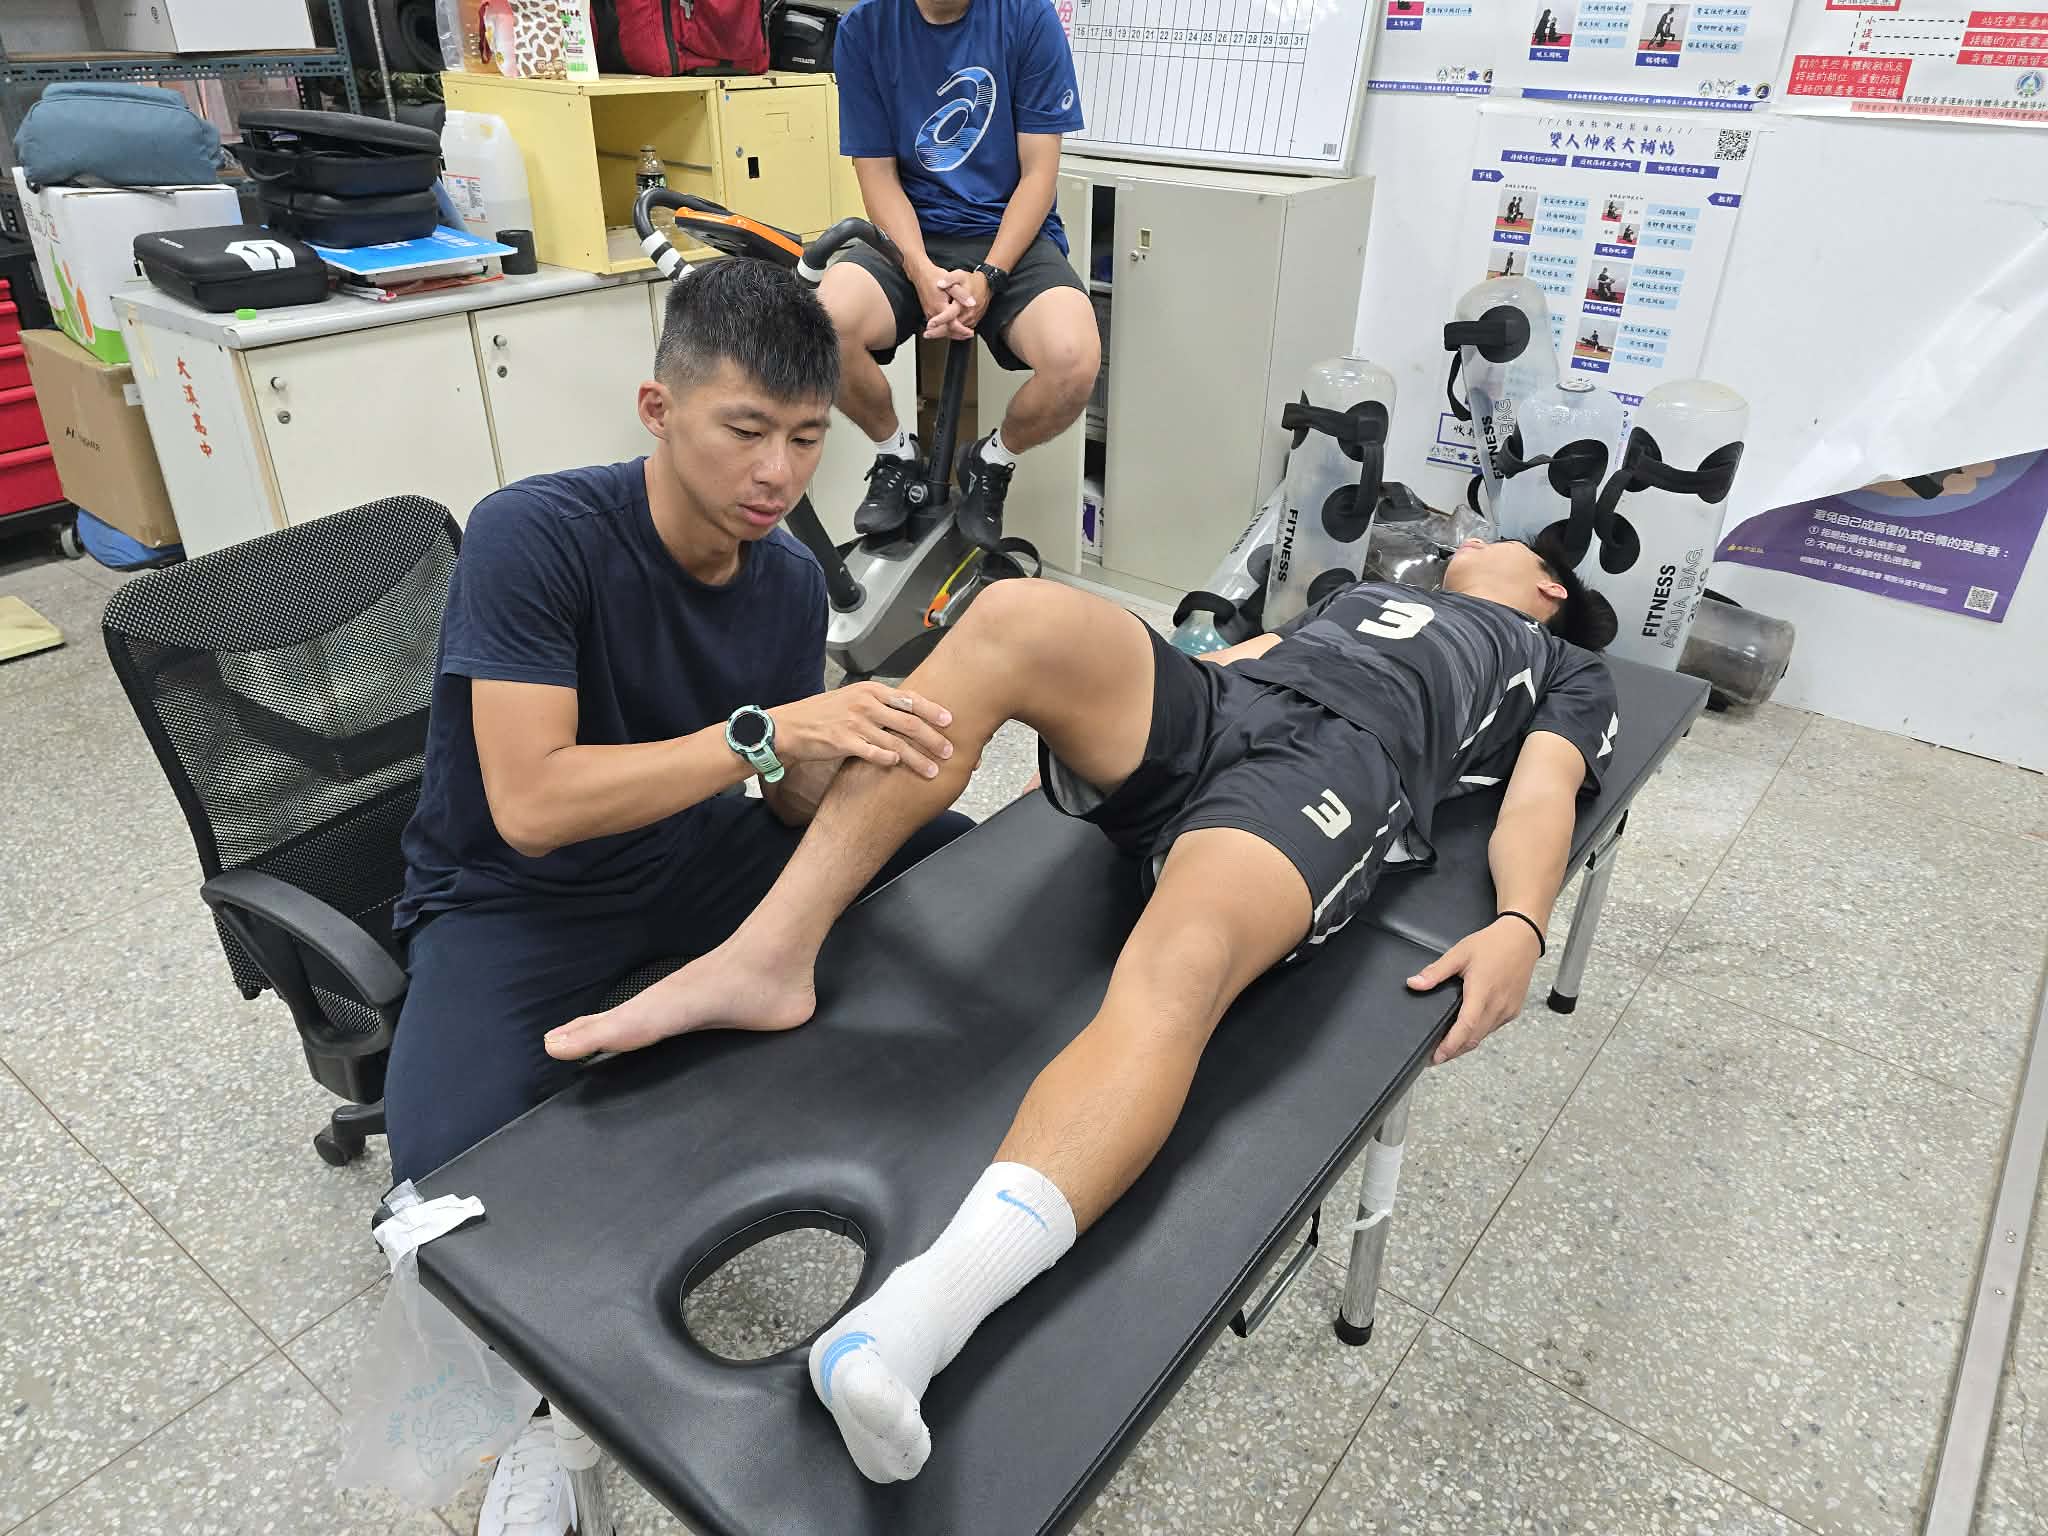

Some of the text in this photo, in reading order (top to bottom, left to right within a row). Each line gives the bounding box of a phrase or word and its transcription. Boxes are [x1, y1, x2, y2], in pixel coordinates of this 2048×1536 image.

[1077, 27, 1305, 46] 16 17 18 19 20 21 22 23 24 25 26 27 28 29 30 31
[1549, 131, 1676, 156] 雙人伸展大補帖
[176, 355, 214, 459] 大溪高中
[1278, 508, 1299, 583] FITNESS
[1678, 548, 1704, 590] BAG
[1641, 564, 1677, 637] FITNESS
